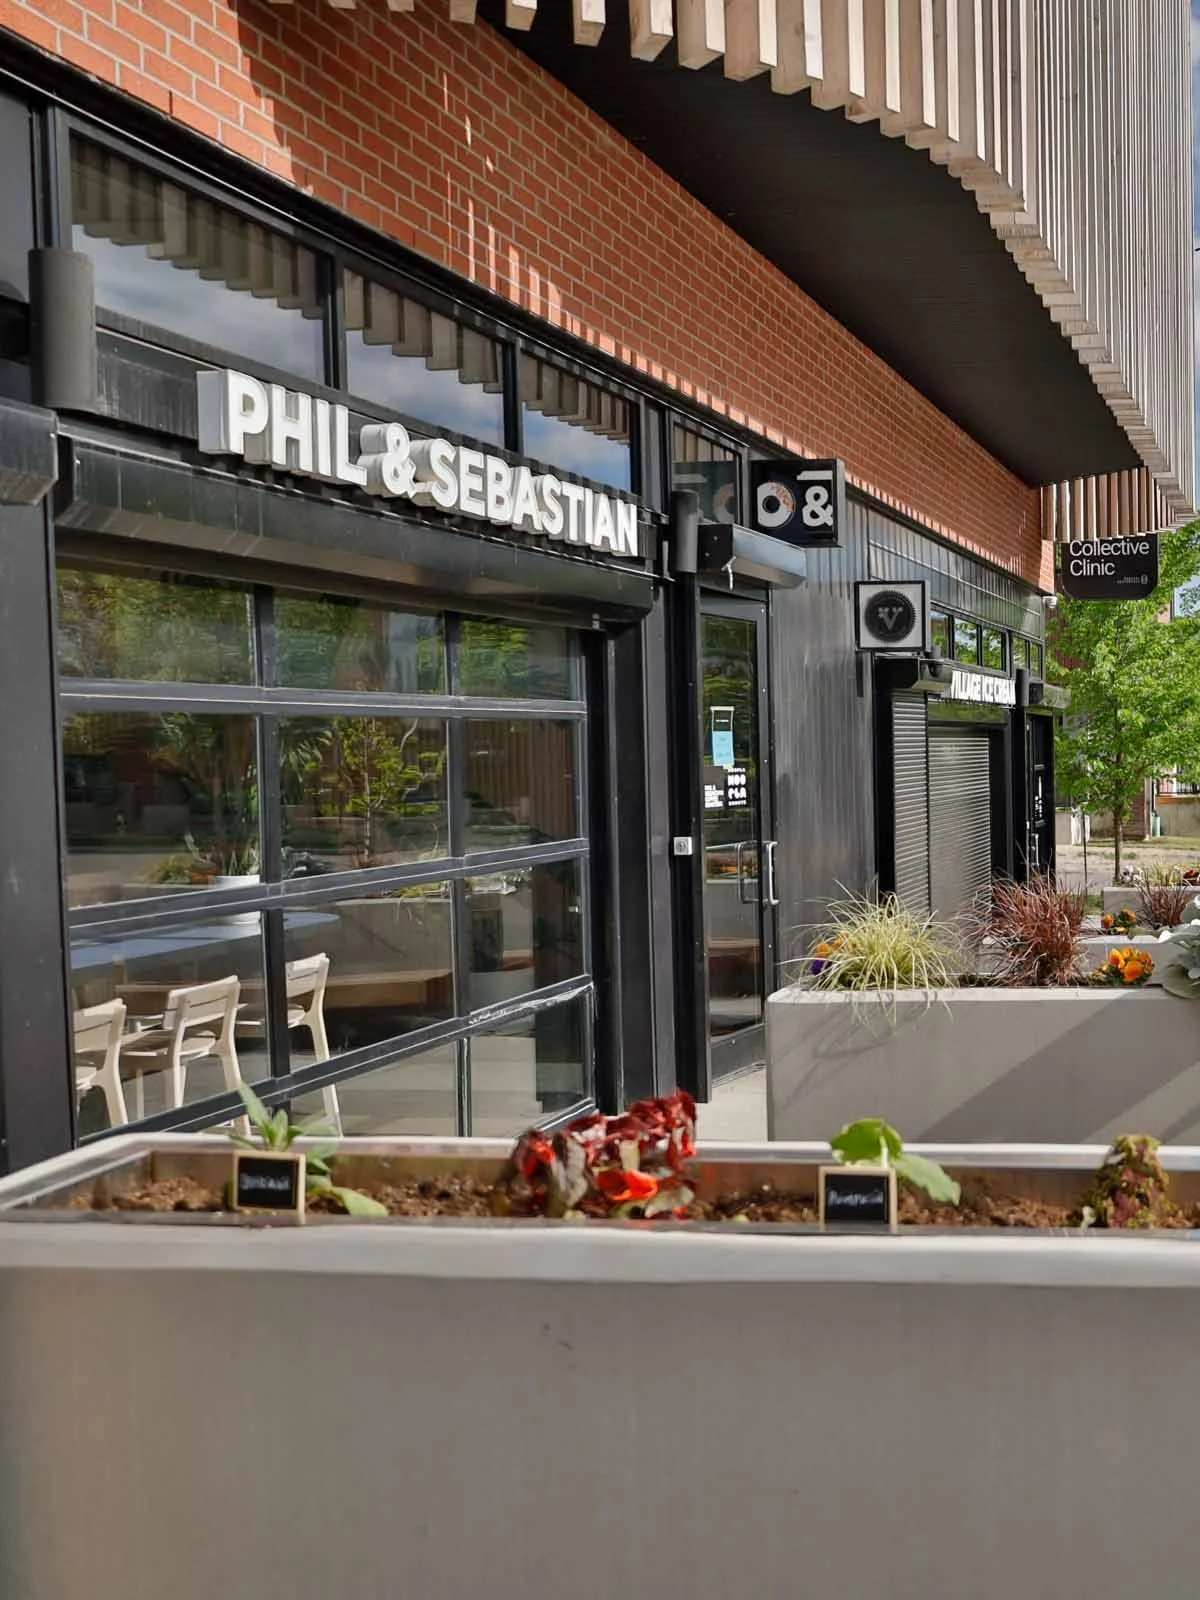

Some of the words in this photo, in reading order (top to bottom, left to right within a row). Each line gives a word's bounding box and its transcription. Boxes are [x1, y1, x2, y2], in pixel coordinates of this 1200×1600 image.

[200, 369, 368, 487] PHIL
[364, 422, 416, 499] &
[424, 438, 638, 558] SEBASTIAN
[1069, 539, 1150, 557] Collective
[1070, 559, 1116, 577] Clinic
